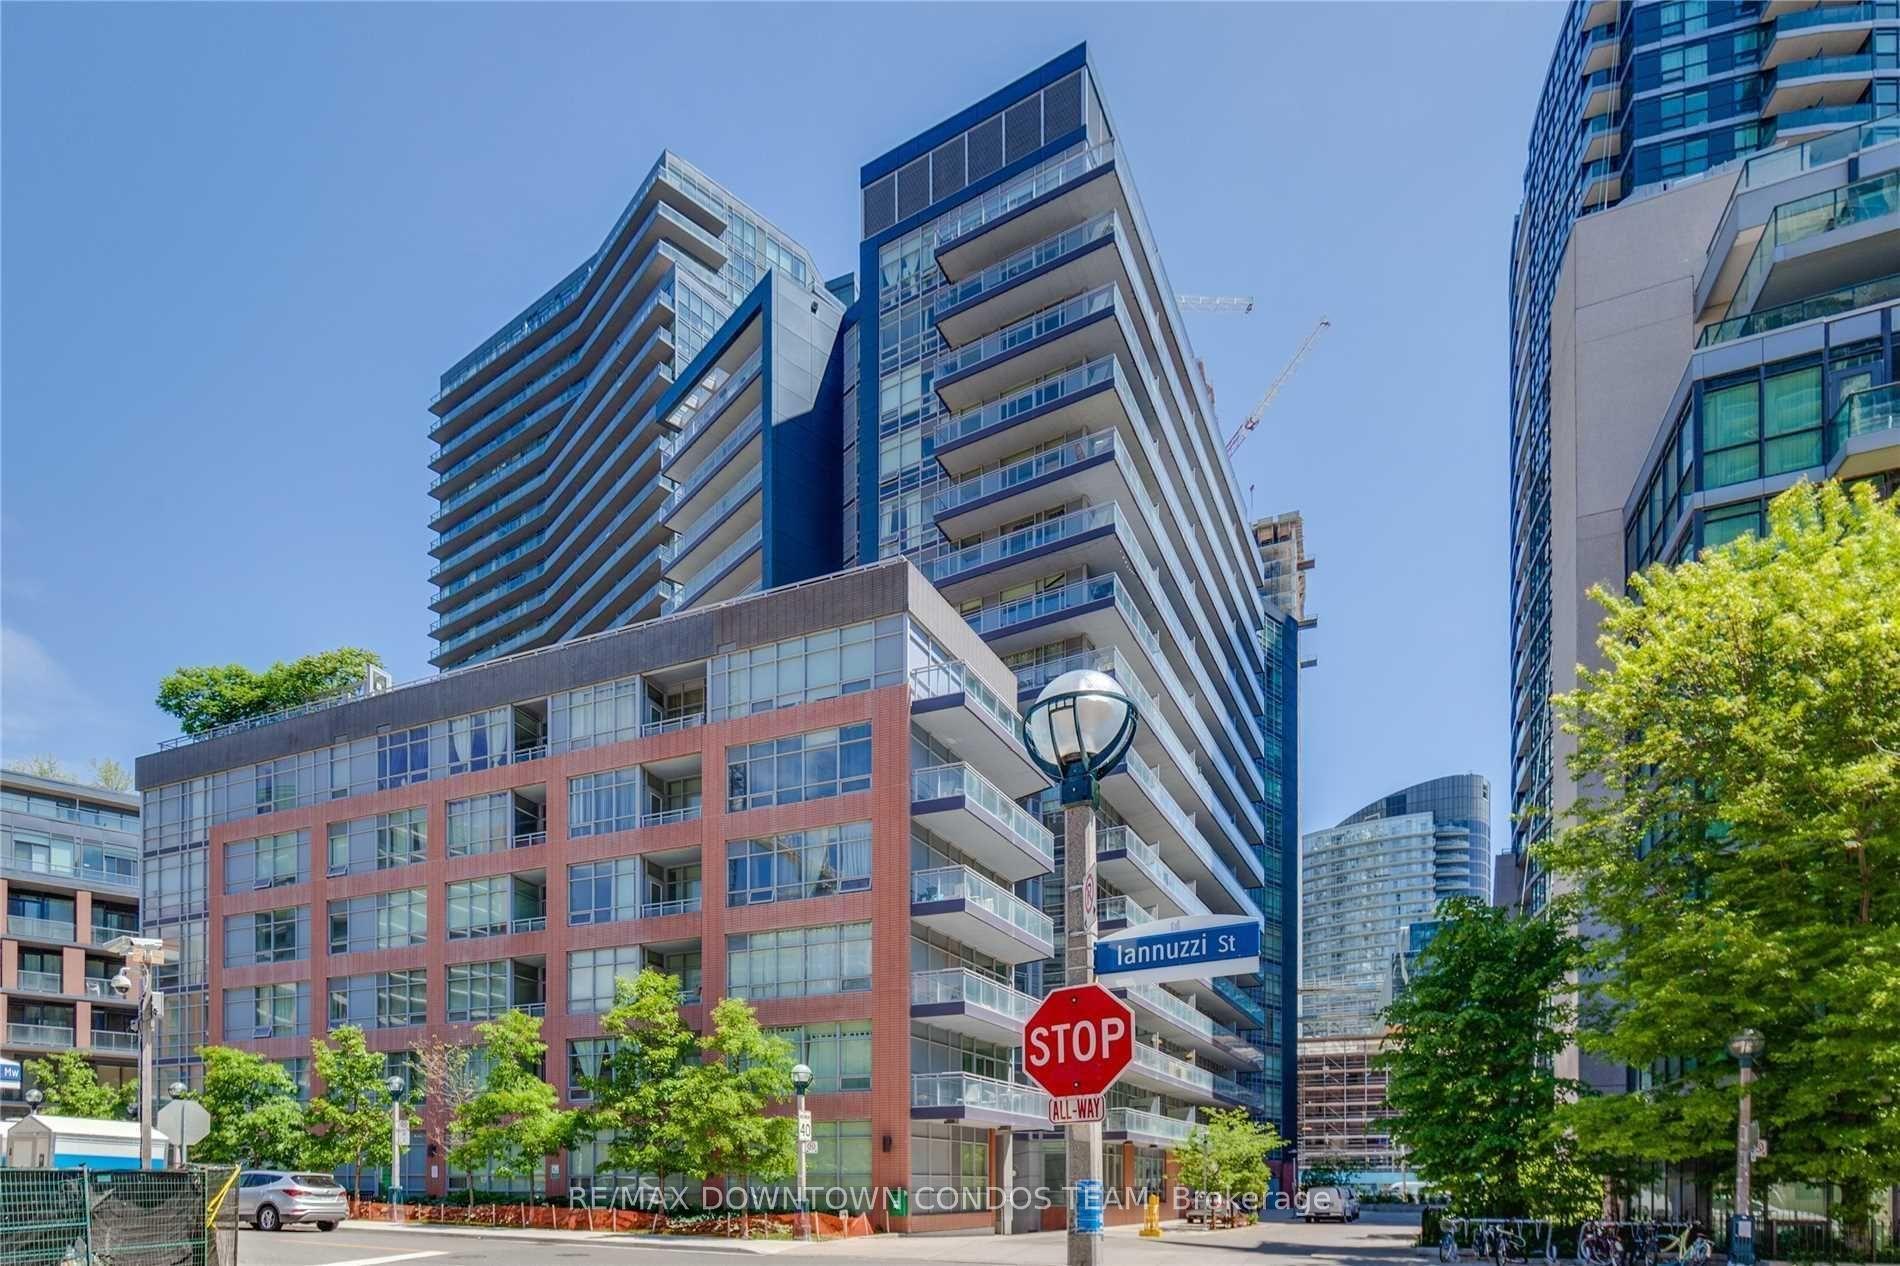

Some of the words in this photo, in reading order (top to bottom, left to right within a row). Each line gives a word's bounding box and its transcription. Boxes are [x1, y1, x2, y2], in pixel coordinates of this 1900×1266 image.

[1117, 933, 1207, 965] Iannuzzi
[1218, 935, 1236, 953] St
[1030, 1017, 1125, 1067] STOP
[1053, 1098, 1100, 1121] ALL-WAY
[800, 1123, 811, 1137] 40
